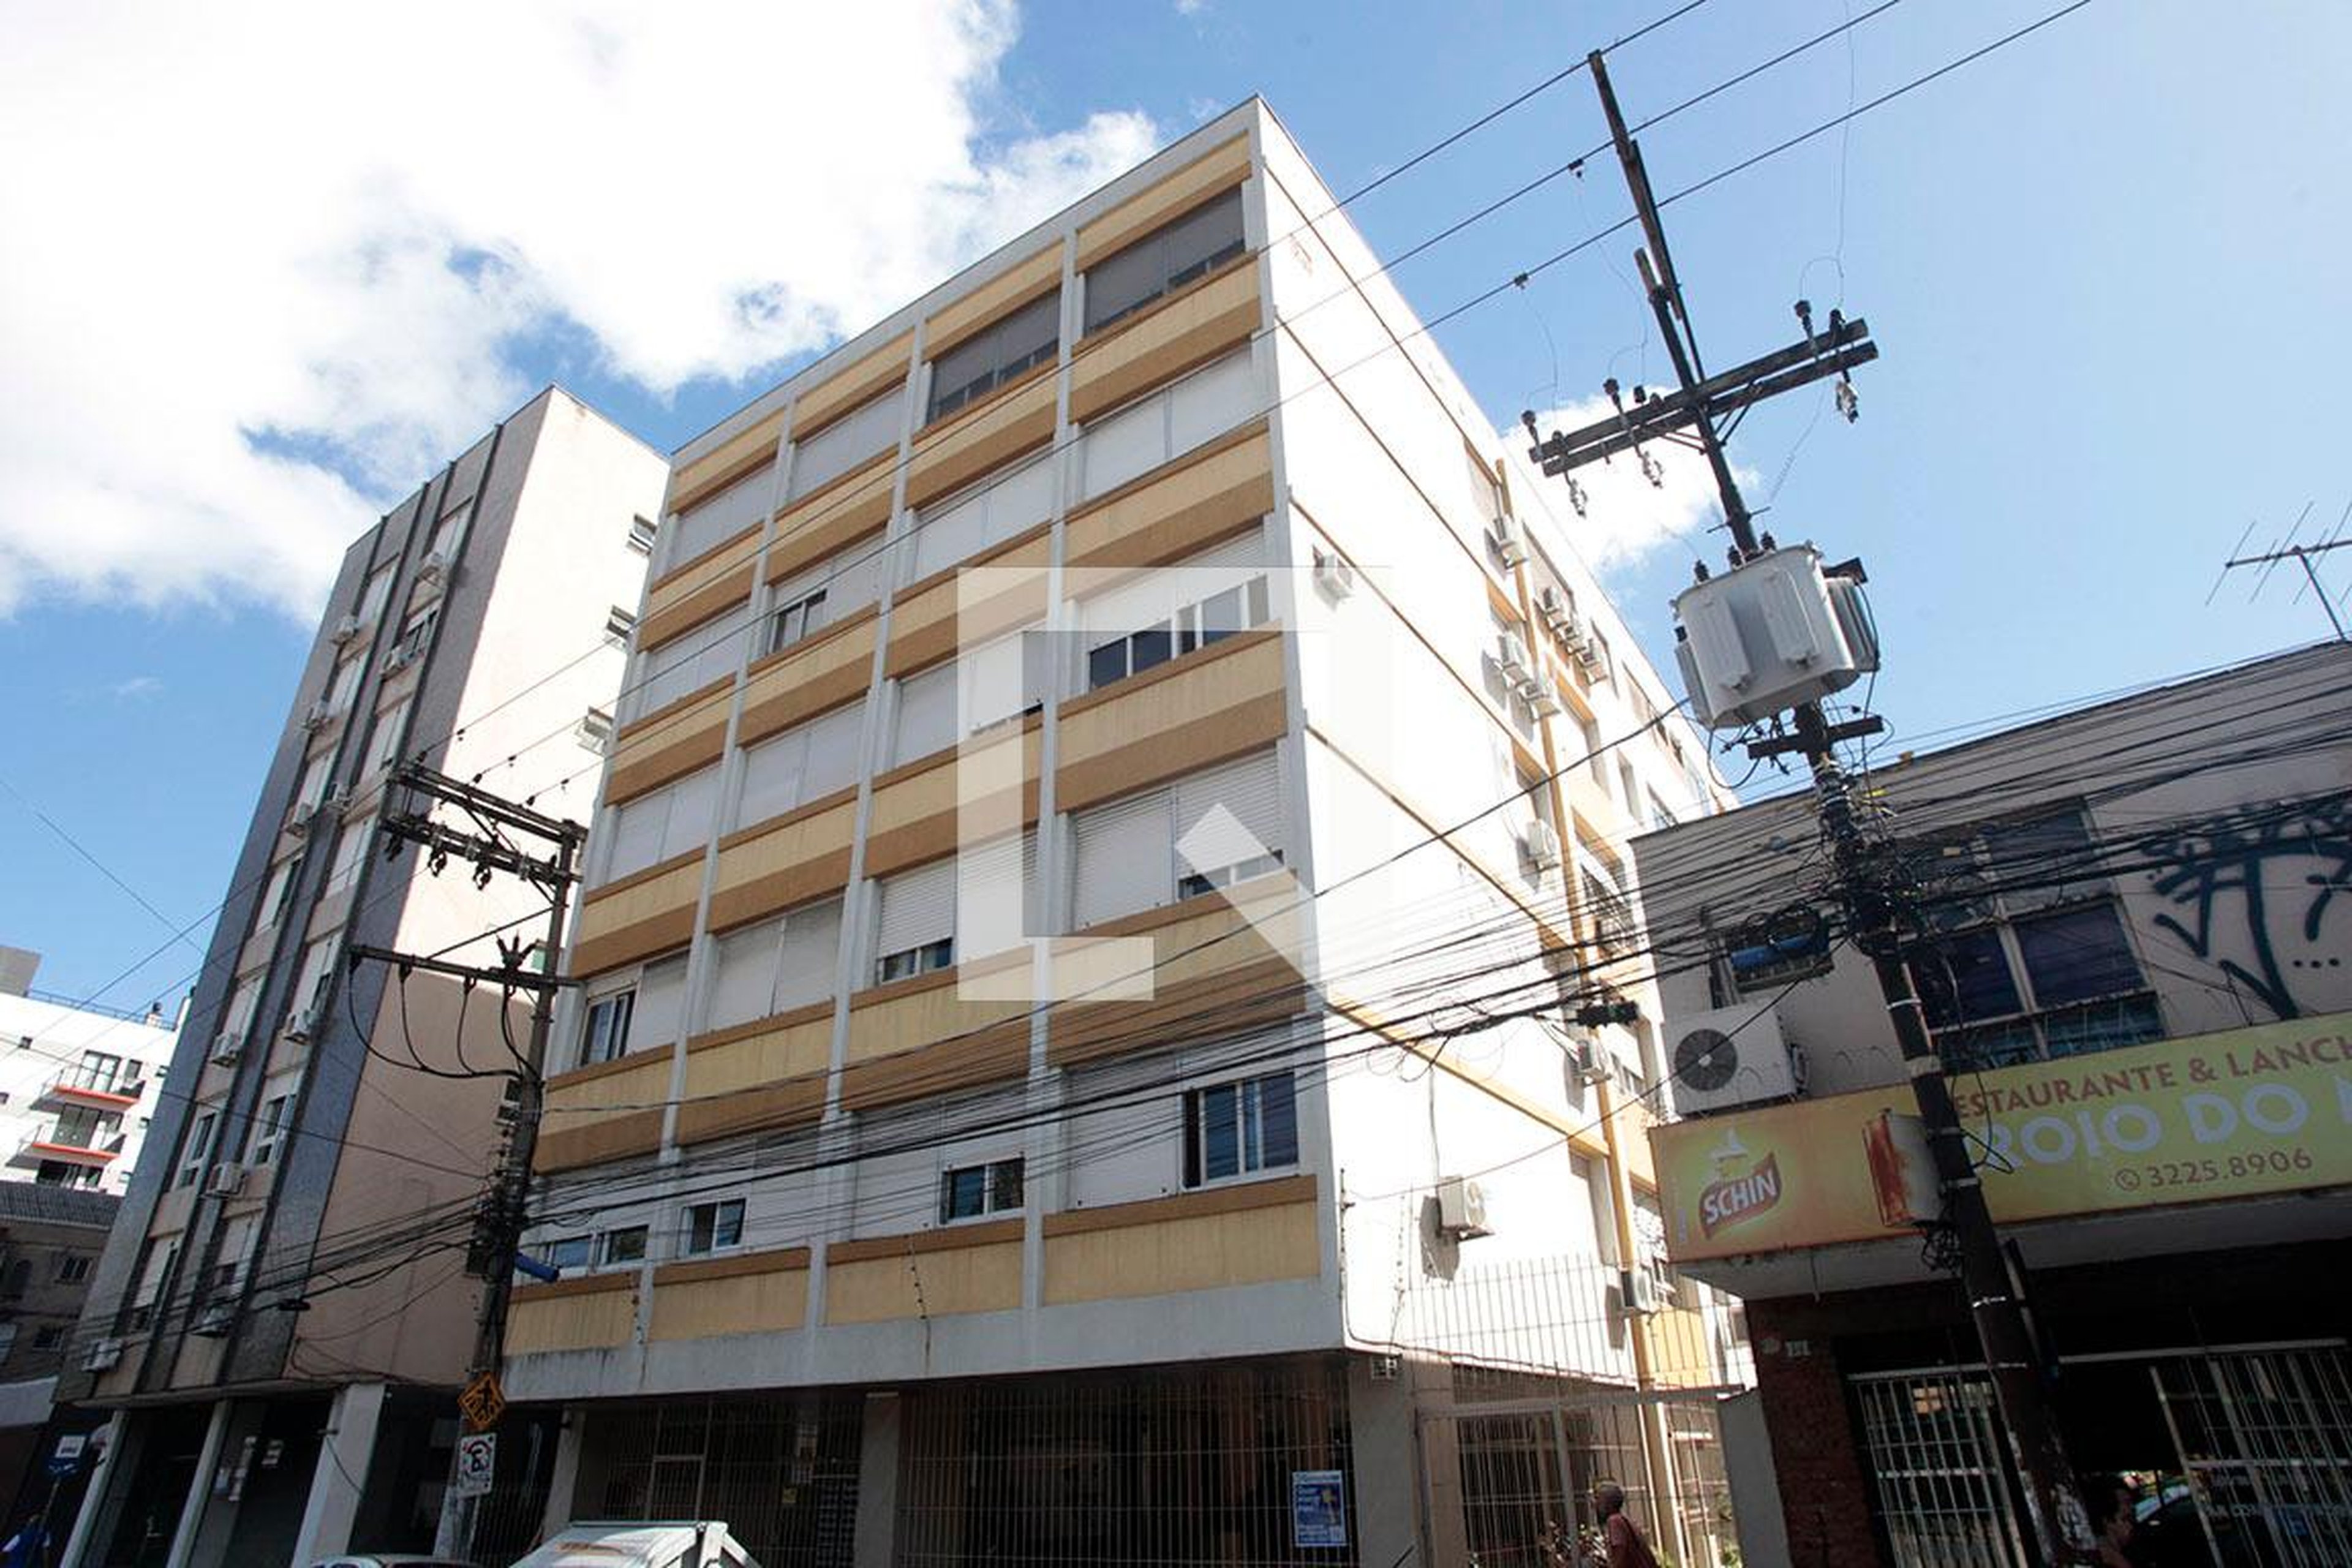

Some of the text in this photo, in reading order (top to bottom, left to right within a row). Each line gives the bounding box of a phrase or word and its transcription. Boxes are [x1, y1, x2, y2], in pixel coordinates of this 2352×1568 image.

[1953, 1062, 2176, 1119] ESTAURANTE
[2188, 1058, 2220, 1084] &
[1962, 1101, 2163, 1169] ROIO
[2182, 1082, 2310, 1144] DO
[1703, 1169, 1777, 1224] SCHIN
[2146, 1147, 2312, 1188] 3225.8906
